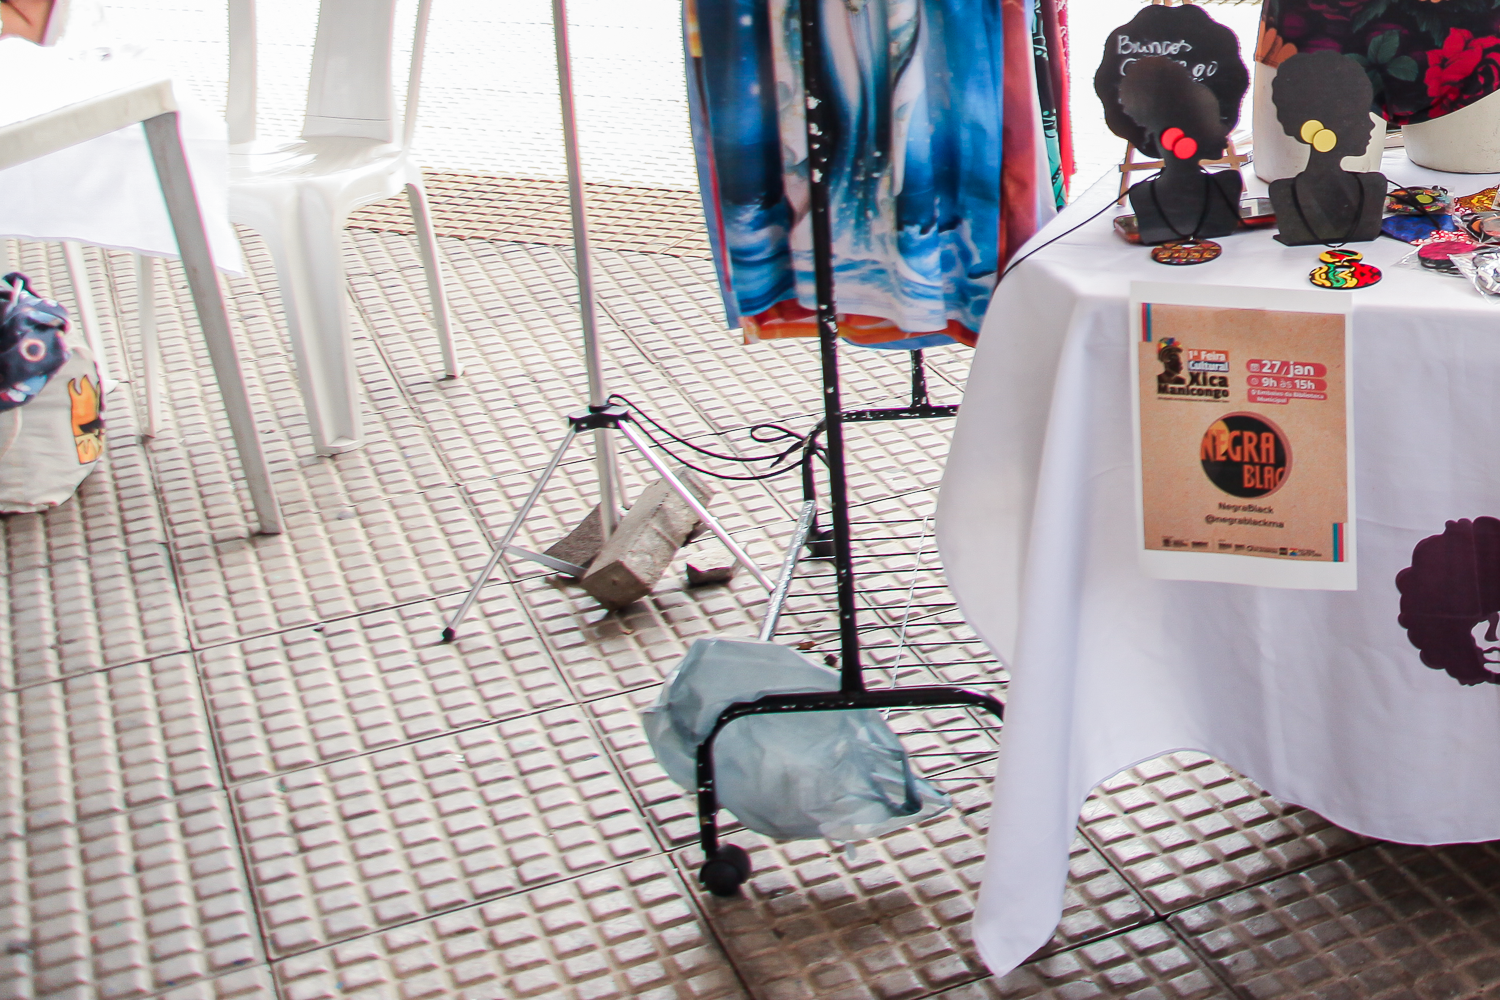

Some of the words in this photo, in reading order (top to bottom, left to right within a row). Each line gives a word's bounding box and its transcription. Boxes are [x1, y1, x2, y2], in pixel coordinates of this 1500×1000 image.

[1200, 351, 1226, 361] Feira
[1188, 372, 1228, 387] Xica
[1261, 377, 1277, 388] 9h
[1294, 379, 1315, 390] 15h
[1200, 429, 1275, 464] NEGRA
